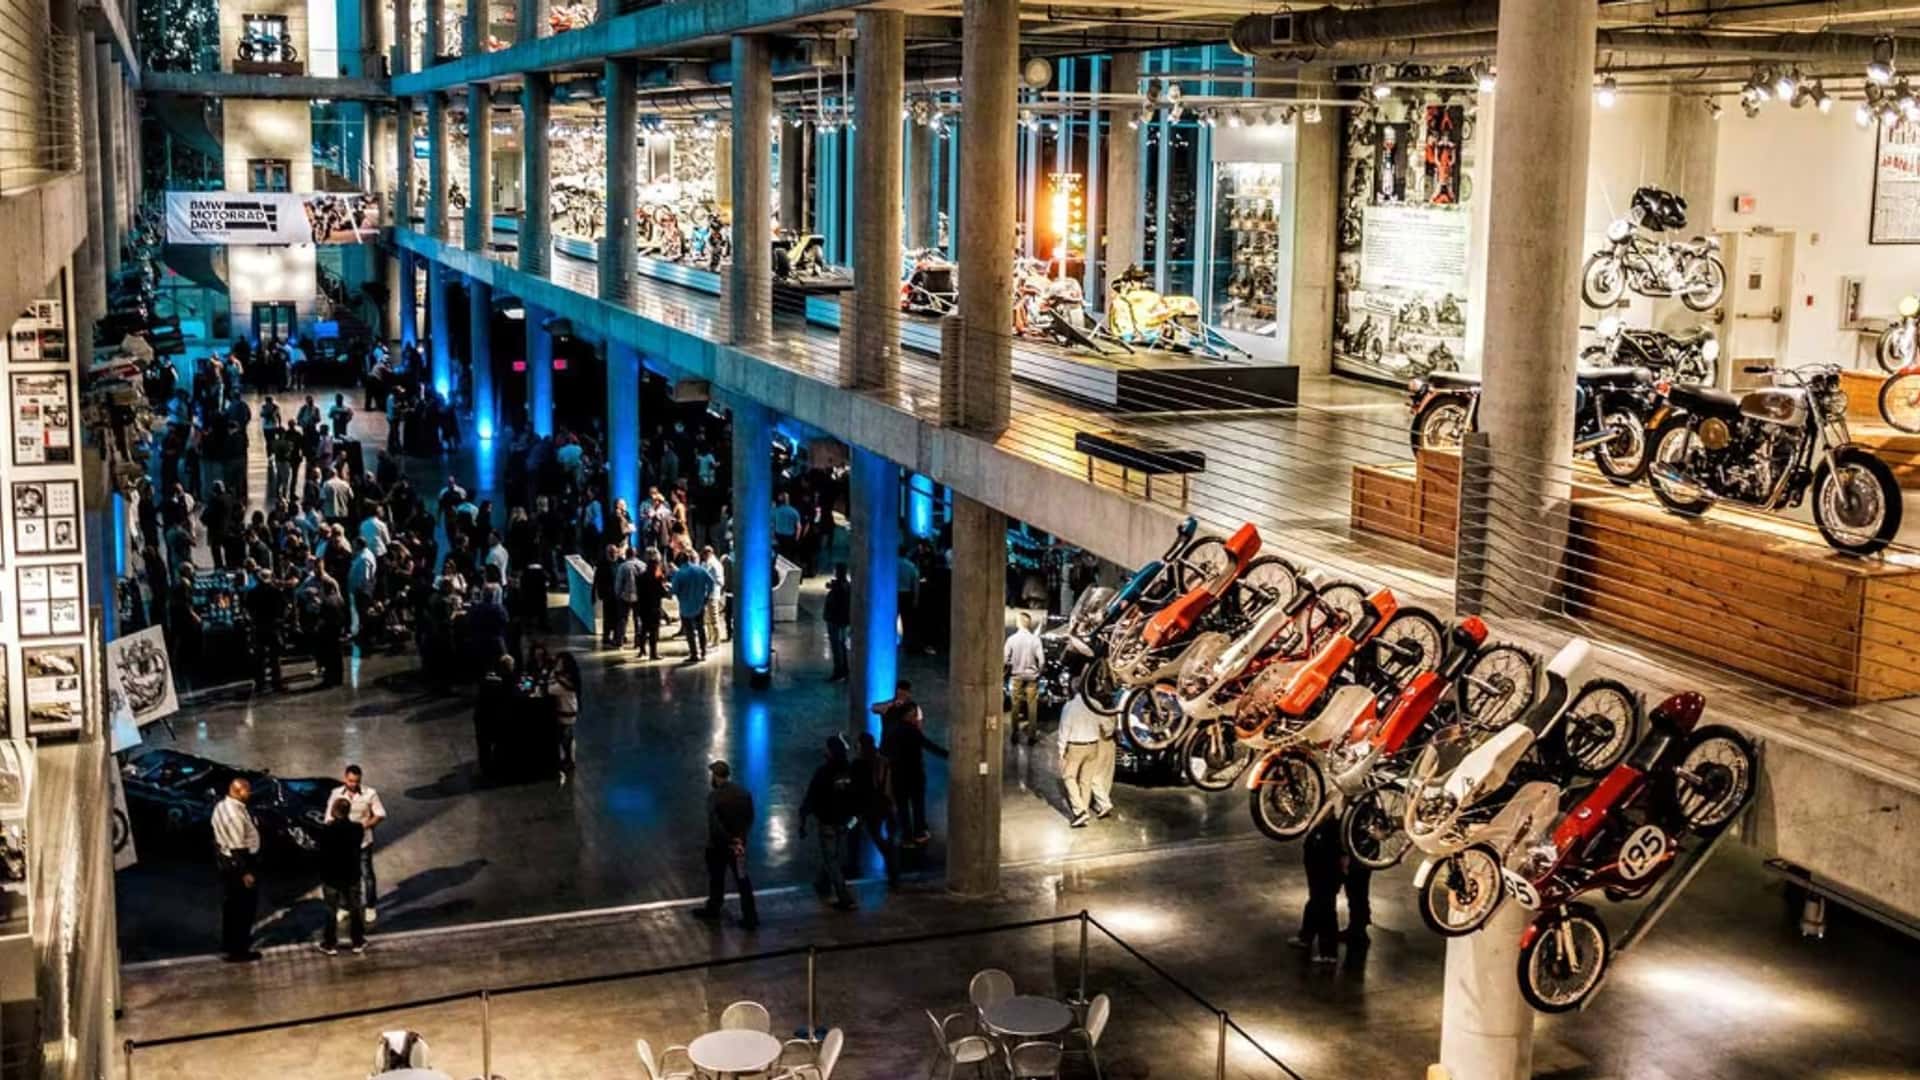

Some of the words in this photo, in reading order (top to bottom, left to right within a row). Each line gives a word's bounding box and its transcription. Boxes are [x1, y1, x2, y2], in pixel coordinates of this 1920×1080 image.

[190, 200, 223, 209] BMW
[190, 210, 264, 220] MOTORRAD
[190, 220, 223, 230] DAYS
[1621, 828, 1663, 877] 195
